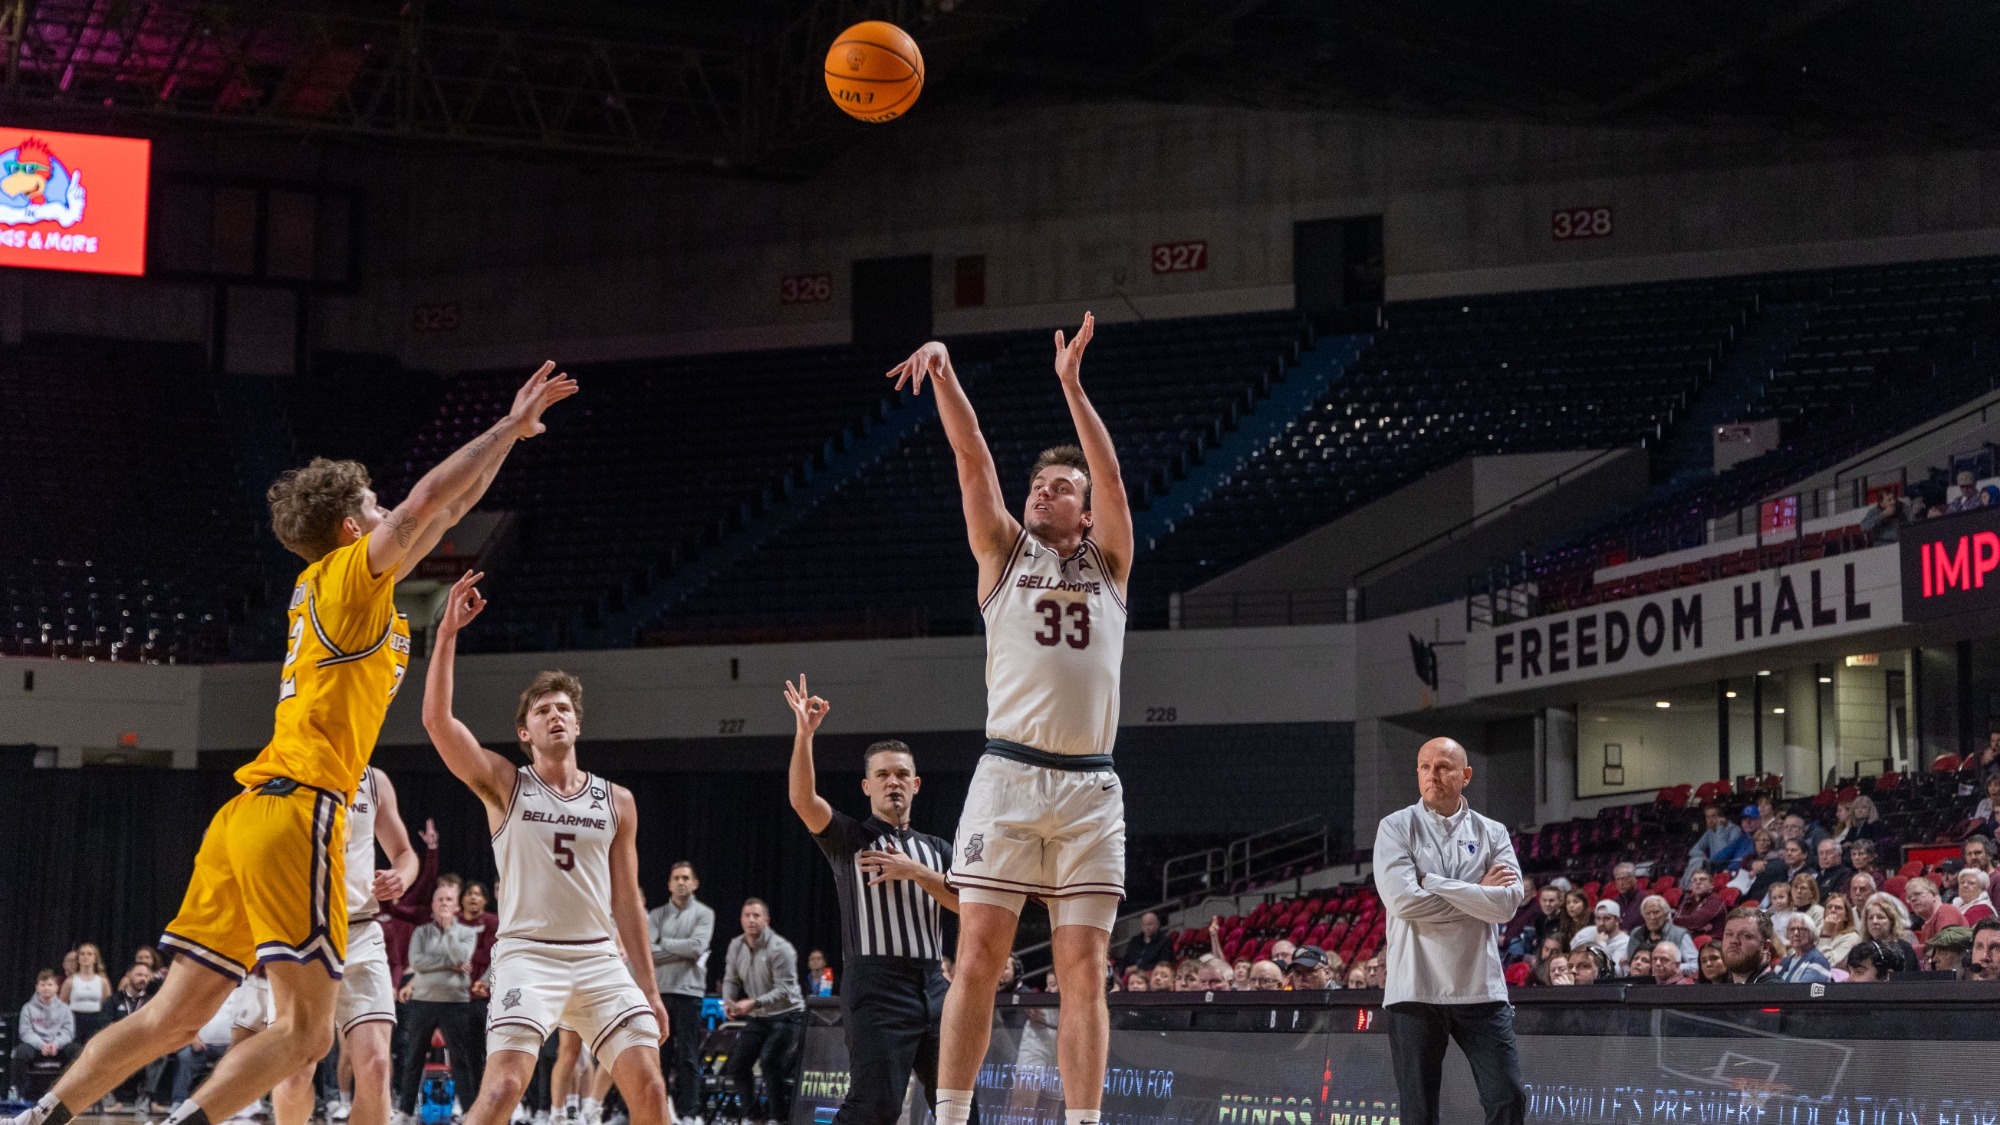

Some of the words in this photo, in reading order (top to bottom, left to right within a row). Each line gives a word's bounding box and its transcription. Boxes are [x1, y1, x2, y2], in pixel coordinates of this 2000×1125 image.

[1553, 208, 1612, 238] 328
[0, 228, 28, 249] GS
[44, 231, 99, 254] MORE
[1154, 243, 1204, 272] 327
[781, 275, 831, 302] 326
[1921, 530, 2000, 599] IMP
[1035, 599, 1090, 650] 33
[1495, 593, 1702, 684] FREEDOM
[1734, 563, 1872, 642] HALL
[719, 718, 744, 734] 227
[1146, 707, 1178, 723] 228
[522, 811, 607, 830] BELLARMINE
[553, 832, 576, 872] 5
[1269, 1010, 1277, 1029] B
[1292, 1010, 1299, 1029] P
[1146, 1069, 1174, 1099] FOR
[1218, 1093, 1312, 1125] FITNESS
